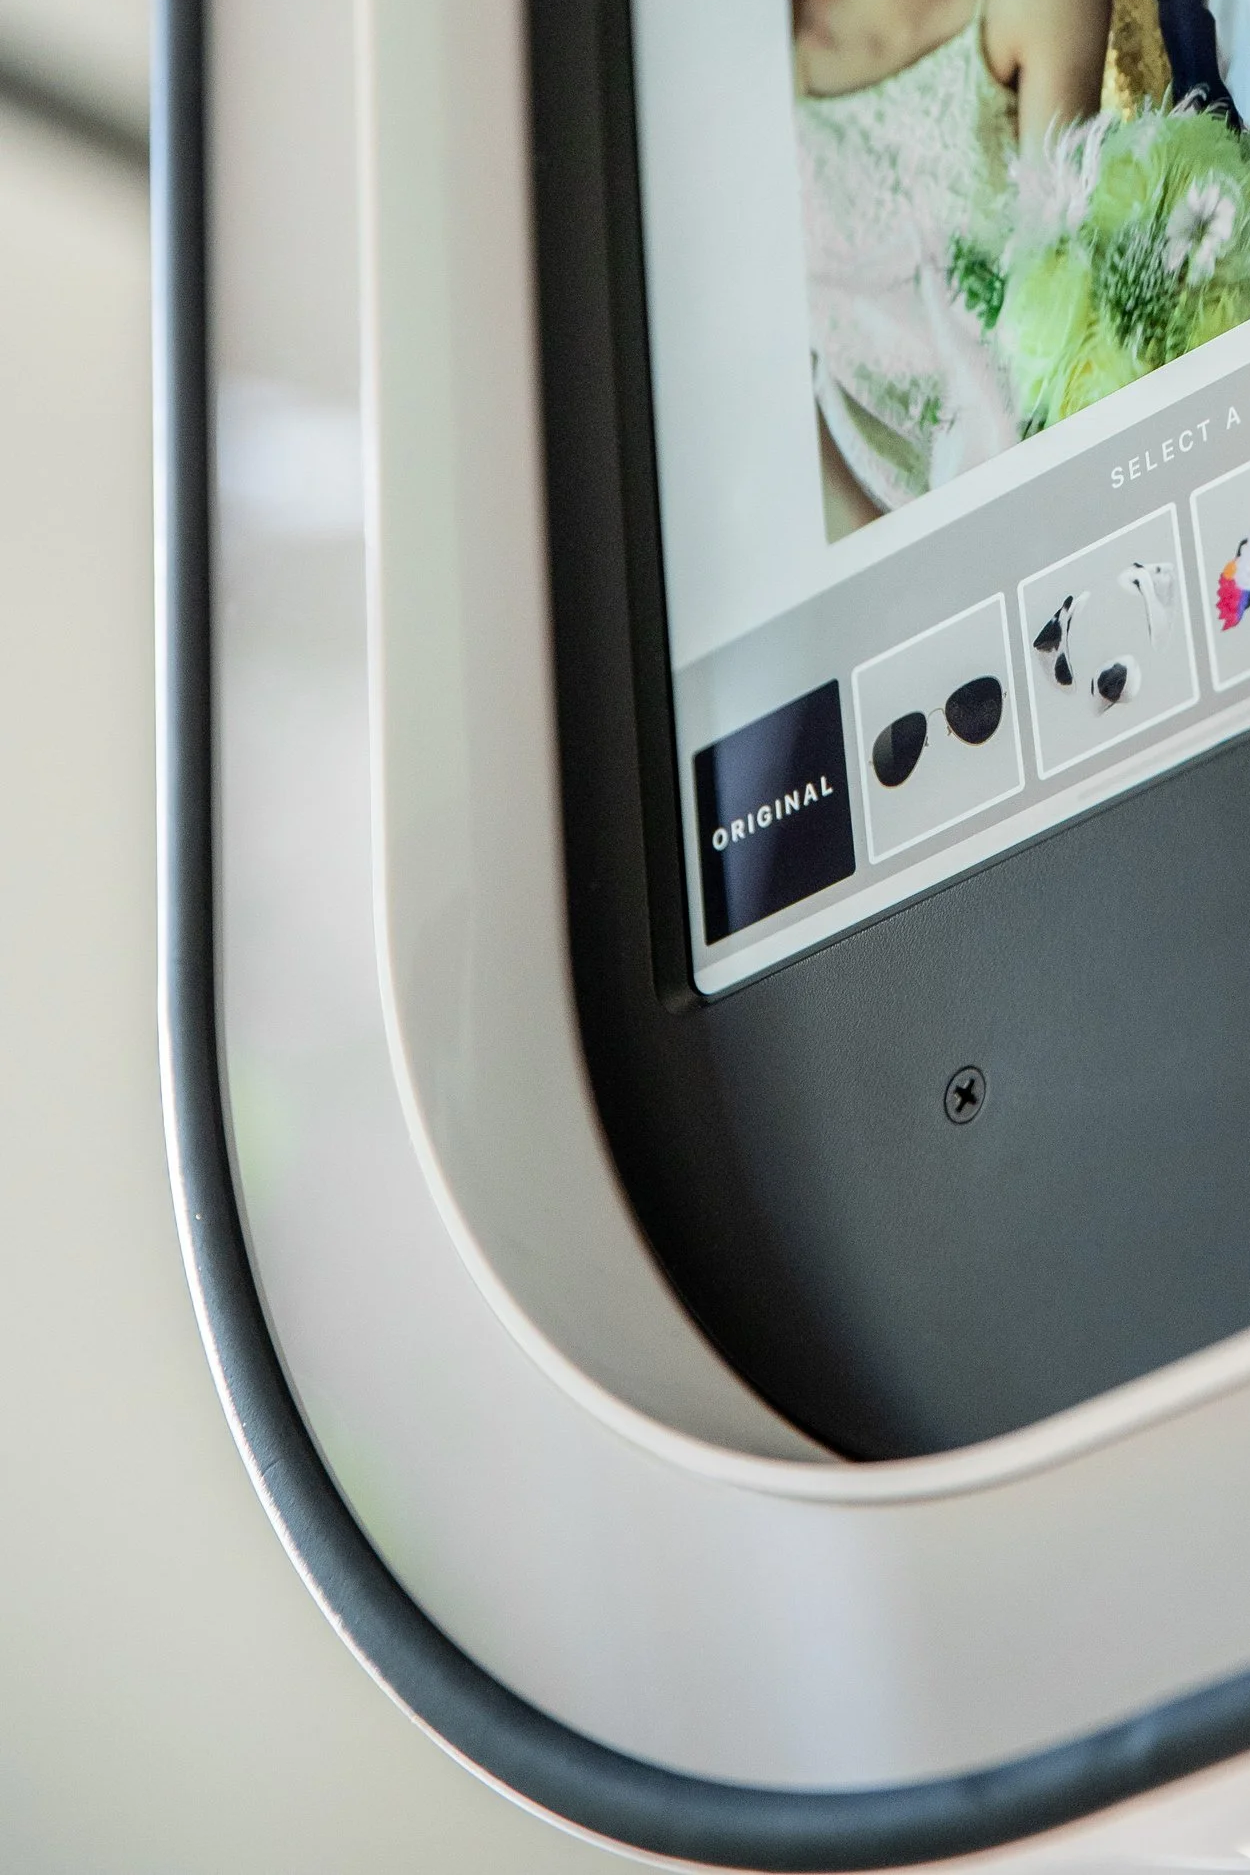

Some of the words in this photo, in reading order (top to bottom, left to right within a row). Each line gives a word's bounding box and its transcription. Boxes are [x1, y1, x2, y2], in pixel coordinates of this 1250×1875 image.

[1110, 419, 1211, 489] SELECT
[1226, 406, 1242, 430] A
[712, 775, 834, 851] ORIGINAL
